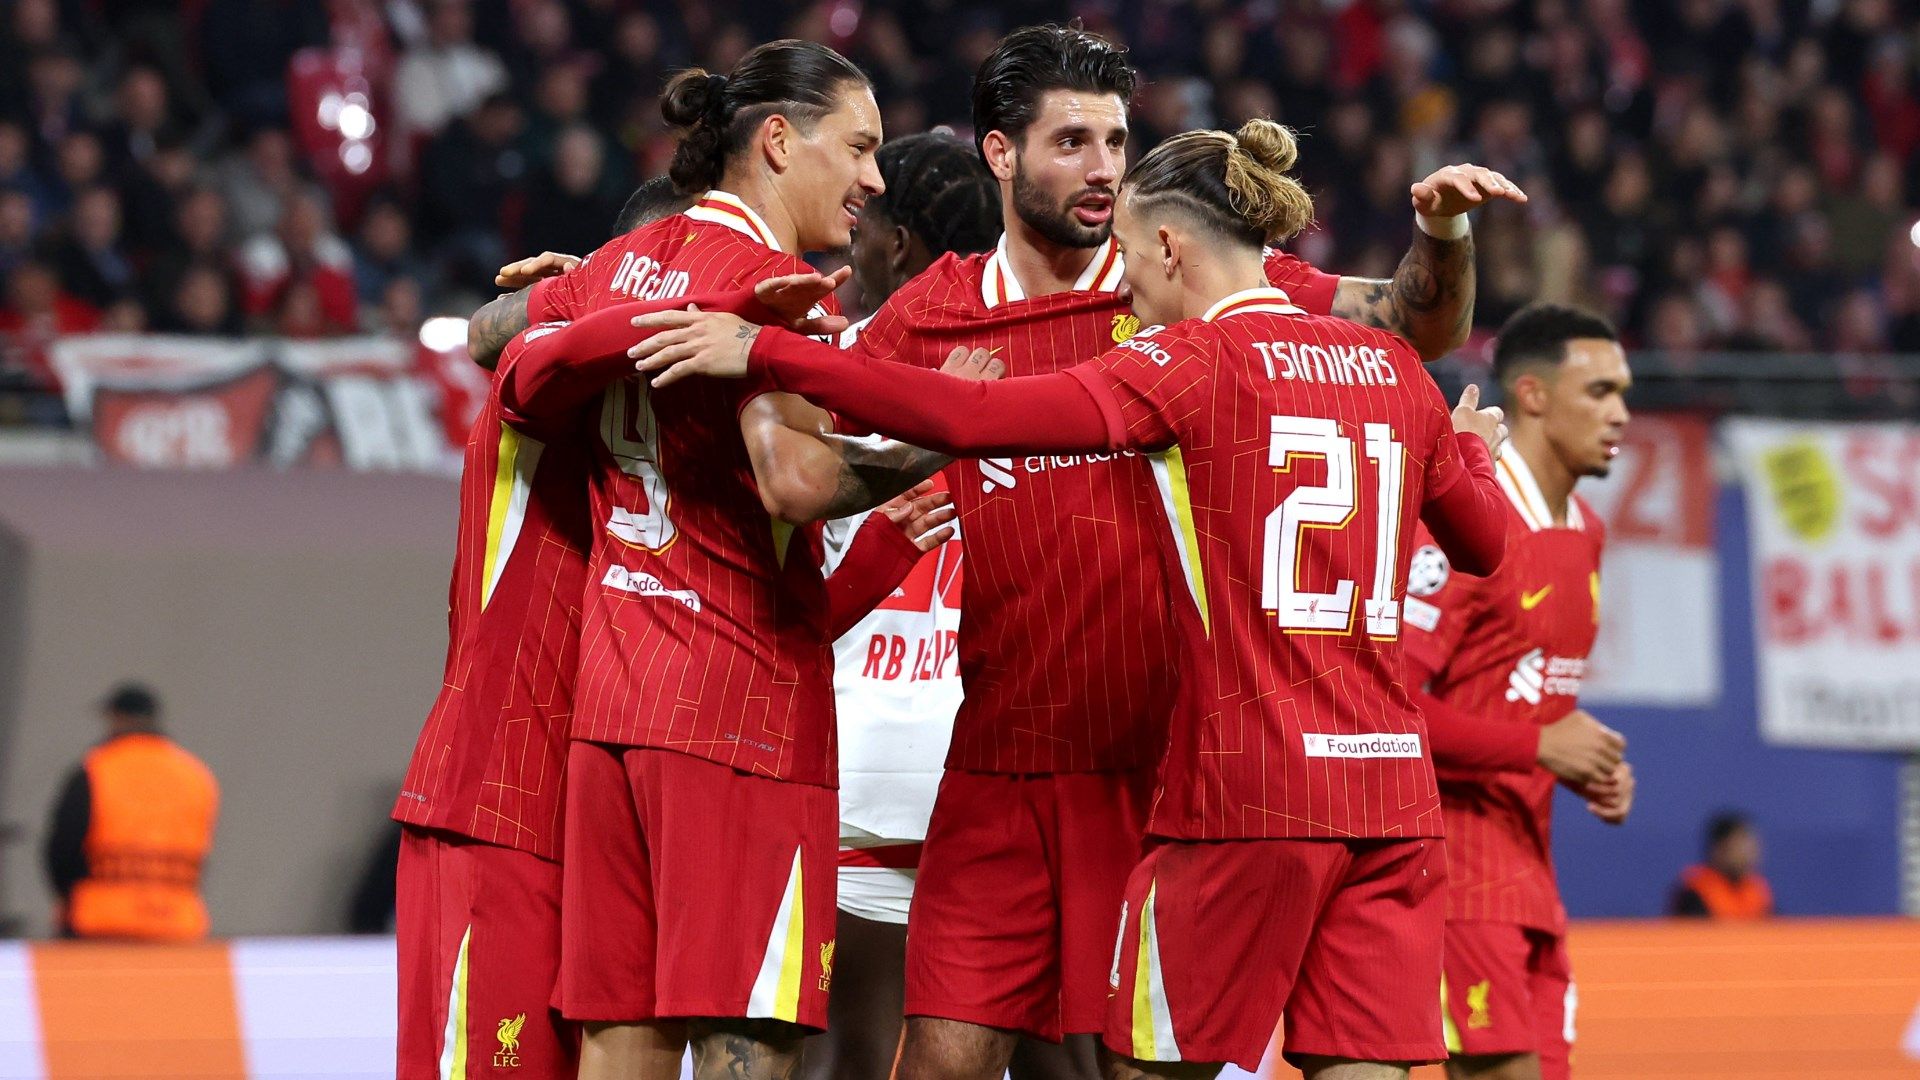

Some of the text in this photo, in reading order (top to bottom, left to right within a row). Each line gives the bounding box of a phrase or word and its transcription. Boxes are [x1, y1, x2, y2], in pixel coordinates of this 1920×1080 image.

[1251, 341, 1398, 386] TSIMIKAS
[600, 372, 679, 556] 9
[1261, 415, 1407, 641] 21
[862, 629, 961, 682] RB LEIP
[1327, 737, 1418, 754] Foundation
[493, 1055, 522, 1067] L.F.C.
